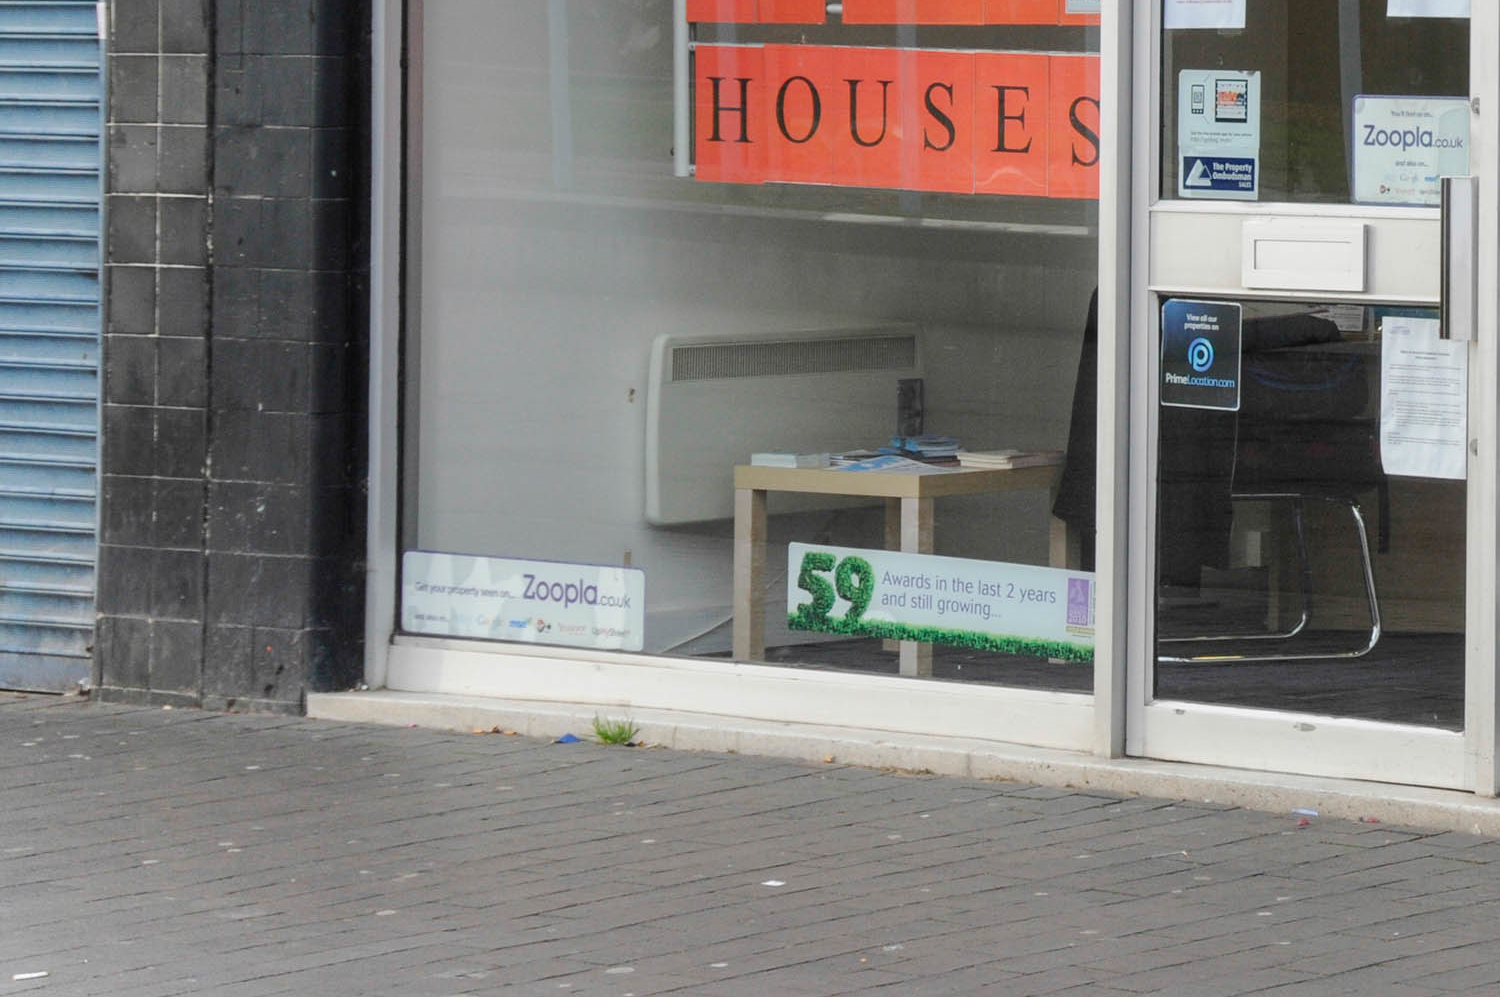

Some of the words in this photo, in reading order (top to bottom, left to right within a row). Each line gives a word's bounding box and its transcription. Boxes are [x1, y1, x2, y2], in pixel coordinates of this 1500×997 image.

[706, 76, 1099, 167] HOUSES
[1363, 124, 1463, 151] Zoopla.co.uk
[1213, 162, 1224, 170] The
[1225, 163, 1252, 172] Property
[1166, 372, 1235, 388] PrimeLocation.com
[430, 584, 446, 594] your
[448, 585, 479, 597] property
[523, 574, 631, 608] Zoopla.co.uk
[797, 552, 875, 624] 59
[882, 571, 931, 590] Awards
[935, 575, 948, 591] in
[952, 577, 974, 594] the
[978, 578, 1002, 597] last
[1007, 583, 1015, 599] 2
[1020, 587, 1056, 604] years
[881, 591, 906, 606] and
[911, 594, 933, 610] still
[937, 597, 1002, 620] growing...
